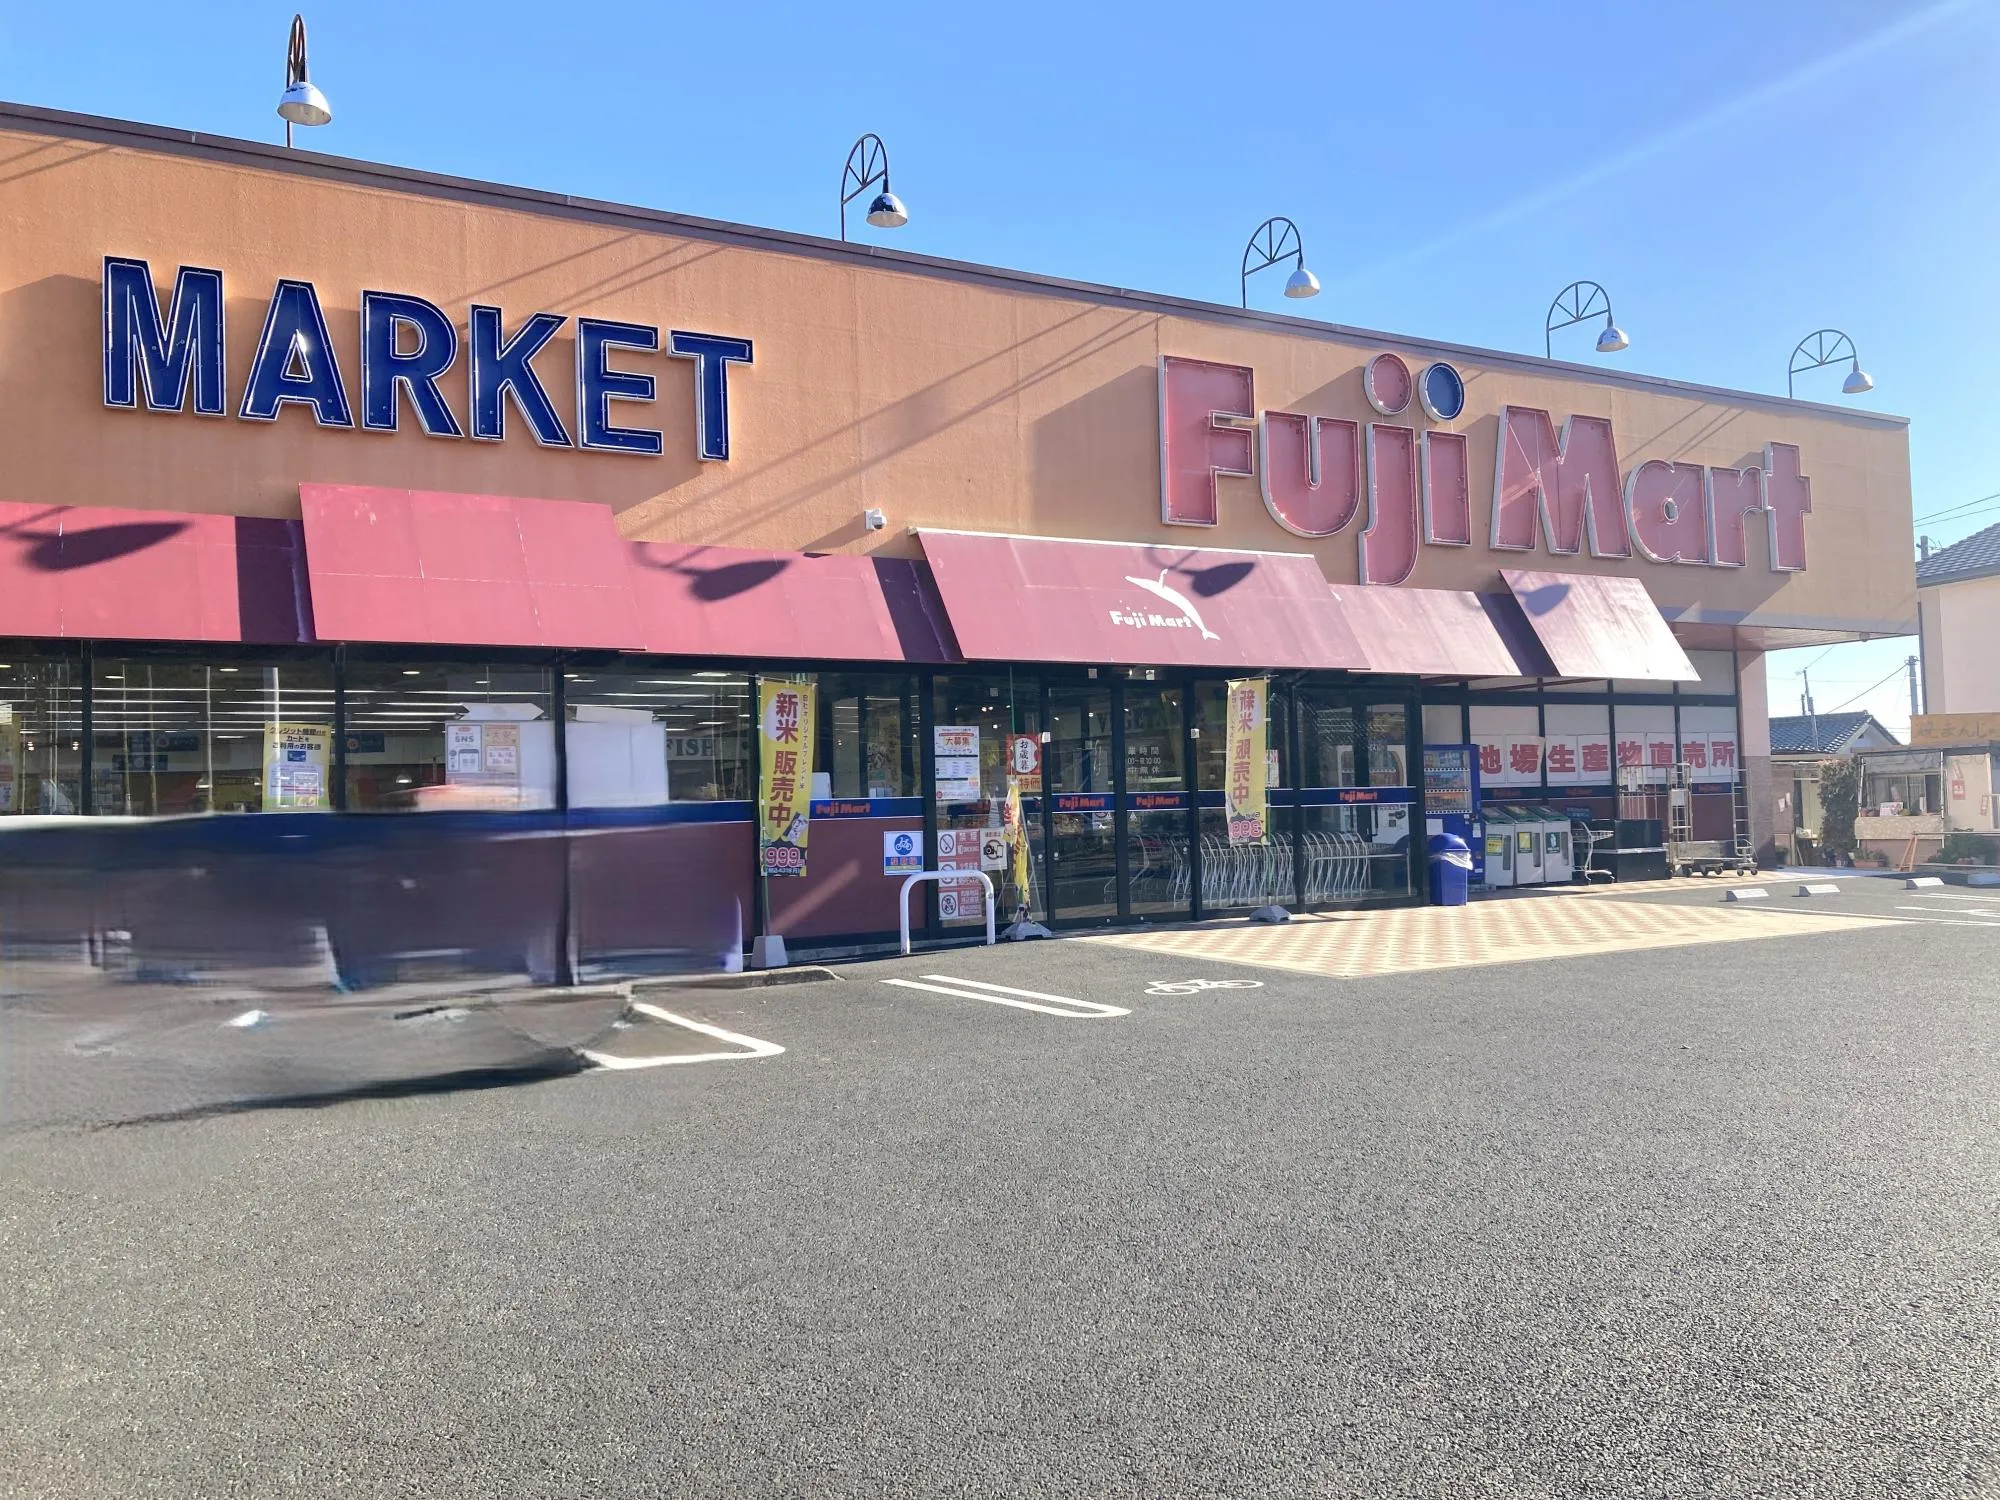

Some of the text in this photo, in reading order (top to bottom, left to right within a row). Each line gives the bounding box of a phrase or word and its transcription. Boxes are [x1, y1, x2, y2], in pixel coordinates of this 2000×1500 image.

[102, 255, 754, 462] MARKET
[1158, 352, 1811, 586] Fuji Mart
[1109, 610, 1192, 628] Fuji Mart
[775, 692, 799, 744] 新米
[454, 735, 474, 743] SNS
[1480, 740, 1735, 774] 地場生産物直売所
[768, 751, 797, 828] 販売中
[1058, 797, 1105, 809] Fuji Mart
[1136, 795, 1179, 807] Fuji Mart
